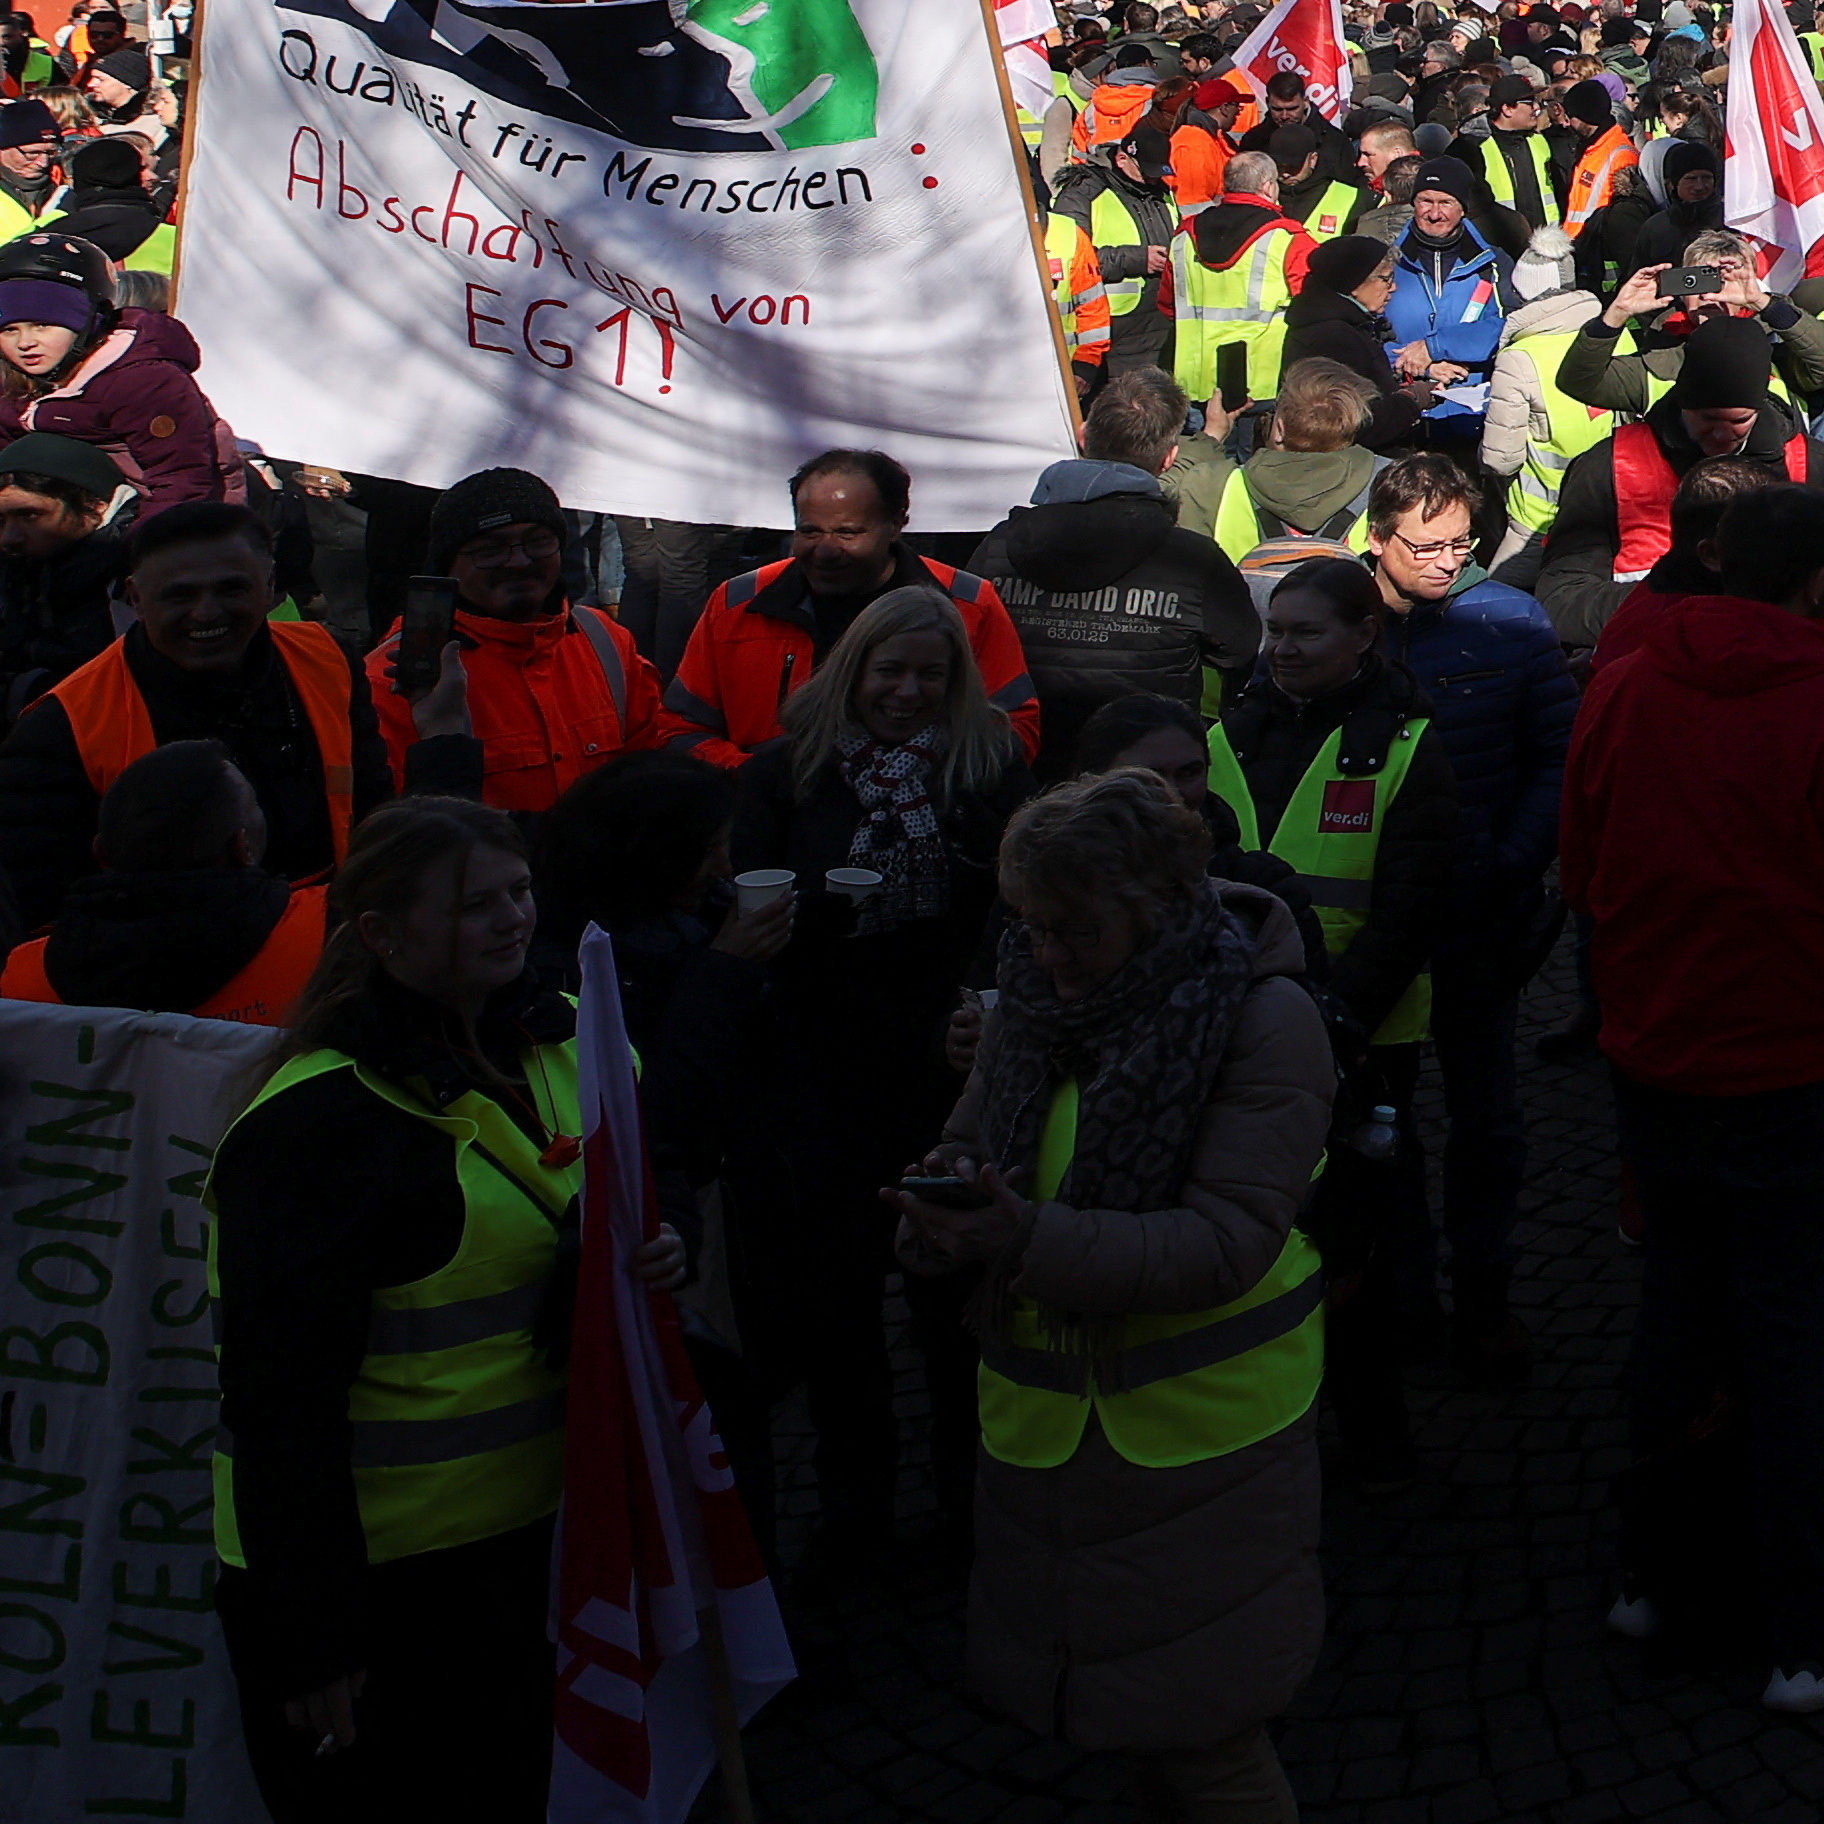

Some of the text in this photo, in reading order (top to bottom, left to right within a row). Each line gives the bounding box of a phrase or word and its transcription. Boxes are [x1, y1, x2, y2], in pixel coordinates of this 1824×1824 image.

[279, 29, 478, 149] Qualität
[498, 122, 586, 179] für
[1266, 35, 1340, 116] verdi
[287, 125, 810, 330] Abschaffung von
[1046, 626, 1110, 643] 63.0125
[1050, 585, 1120, 614] DAVID
[1124, 586, 1183, 620] ORIG.
